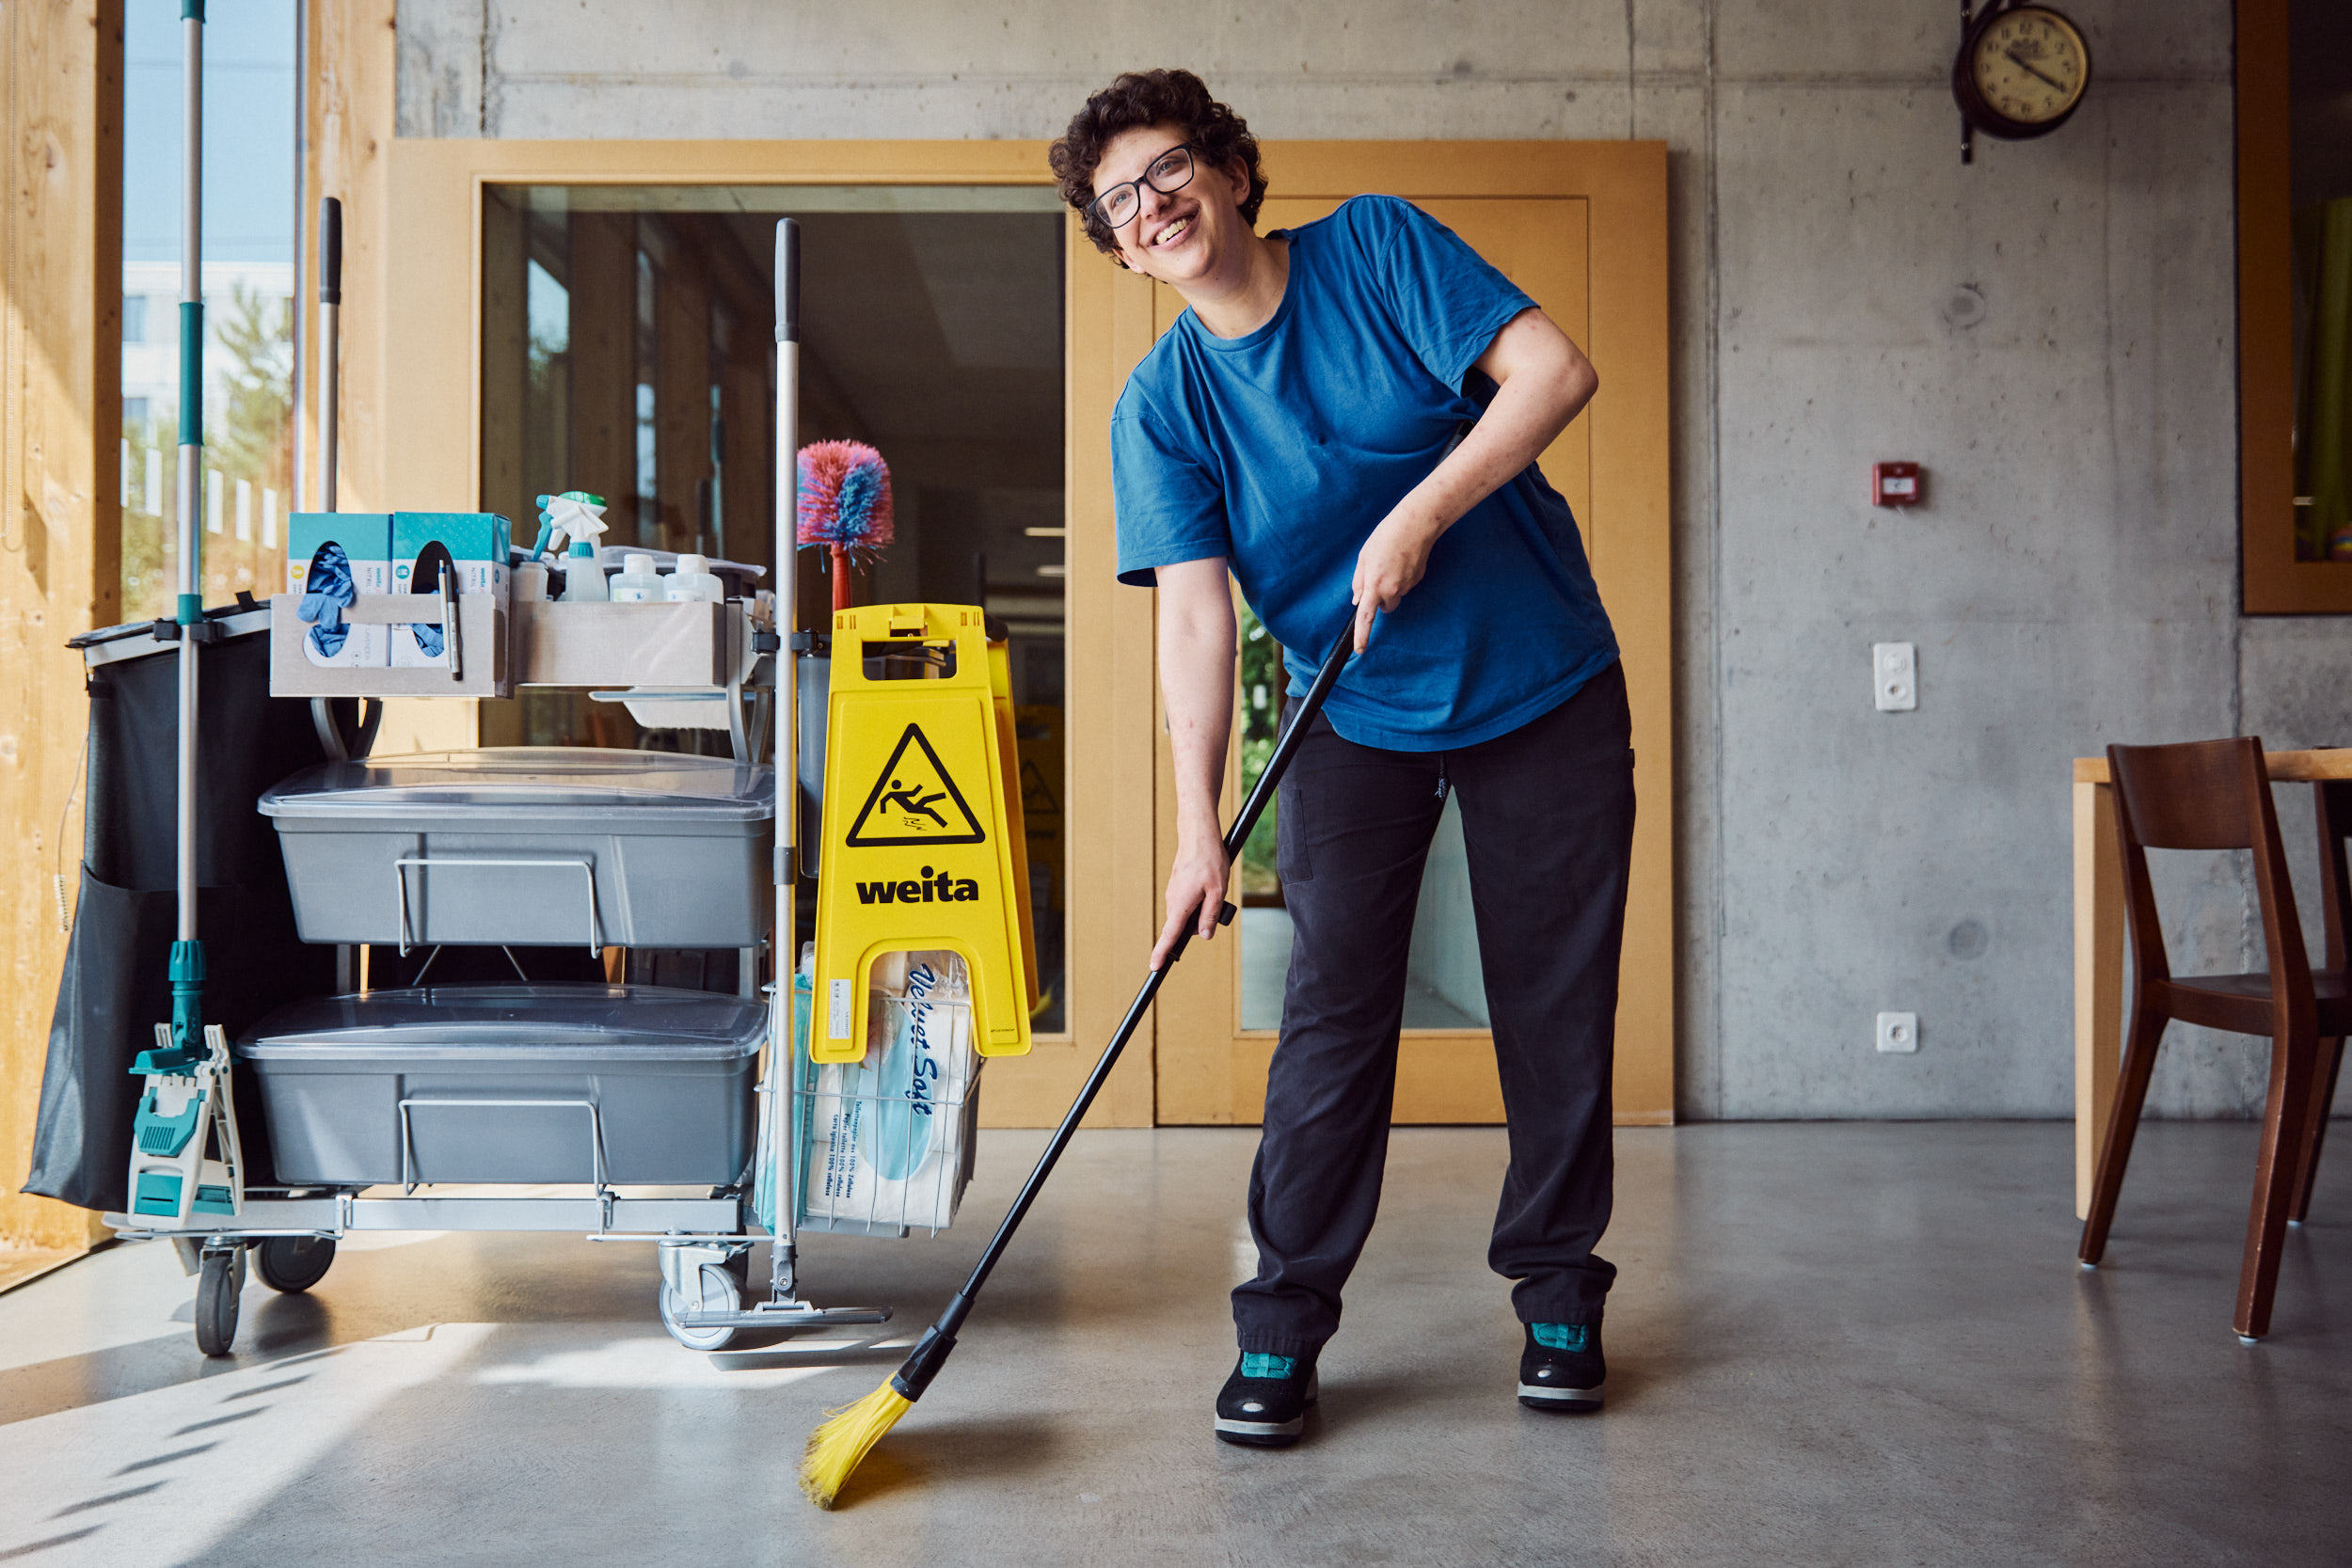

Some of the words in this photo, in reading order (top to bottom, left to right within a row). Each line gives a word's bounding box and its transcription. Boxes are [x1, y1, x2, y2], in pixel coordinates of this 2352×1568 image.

[855, 865, 979, 905] weita
[909, 963, 936, 1050] Velvet
[904, 1054, 938, 1117] Soft
[842, 1113, 850, 1131] Papier
[850, 1101, 862, 1142] Toilettenpapier
